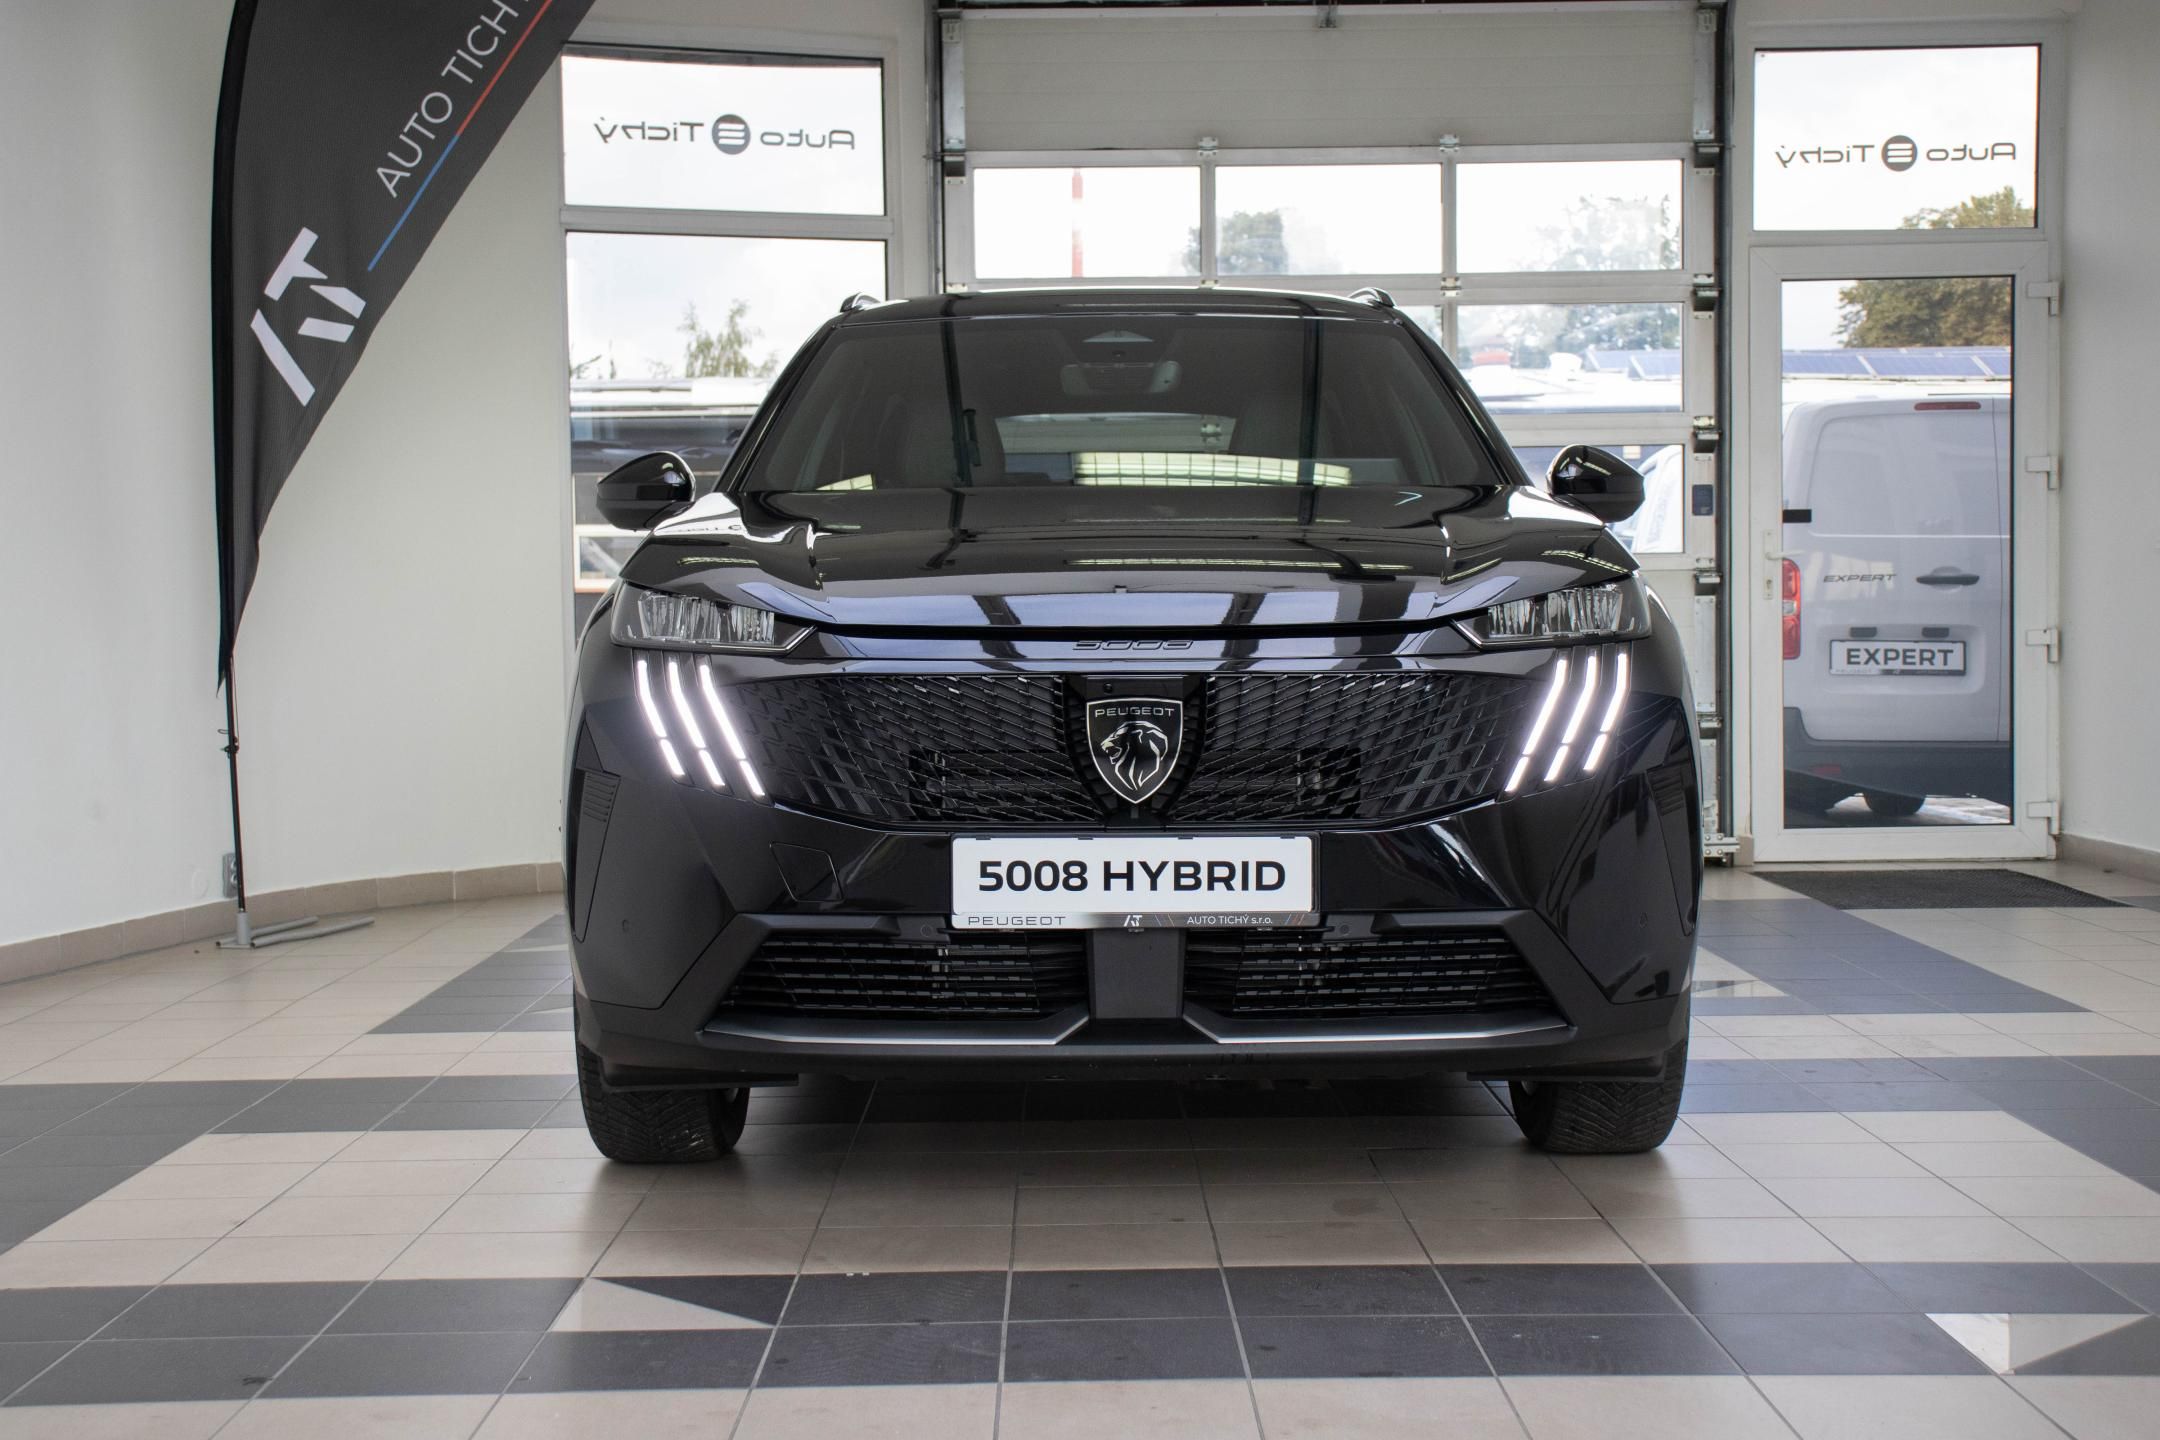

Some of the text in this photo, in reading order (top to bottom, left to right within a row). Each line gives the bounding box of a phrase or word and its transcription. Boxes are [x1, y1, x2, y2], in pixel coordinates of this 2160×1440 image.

[375, 0, 529, 198] AUTO TICH
[1823, 574, 1897, 583] EXPERT
[1847, 648, 1954, 666] EXPERT
[1095, 706, 1175, 717] PEUGEOT
[978, 861, 1286, 892] 5008 HYBRID
[968, 915, 1066, 926] PEUGEOT
[1187, 913, 1273, 925] AUTO TICHÝ s.r.o.
